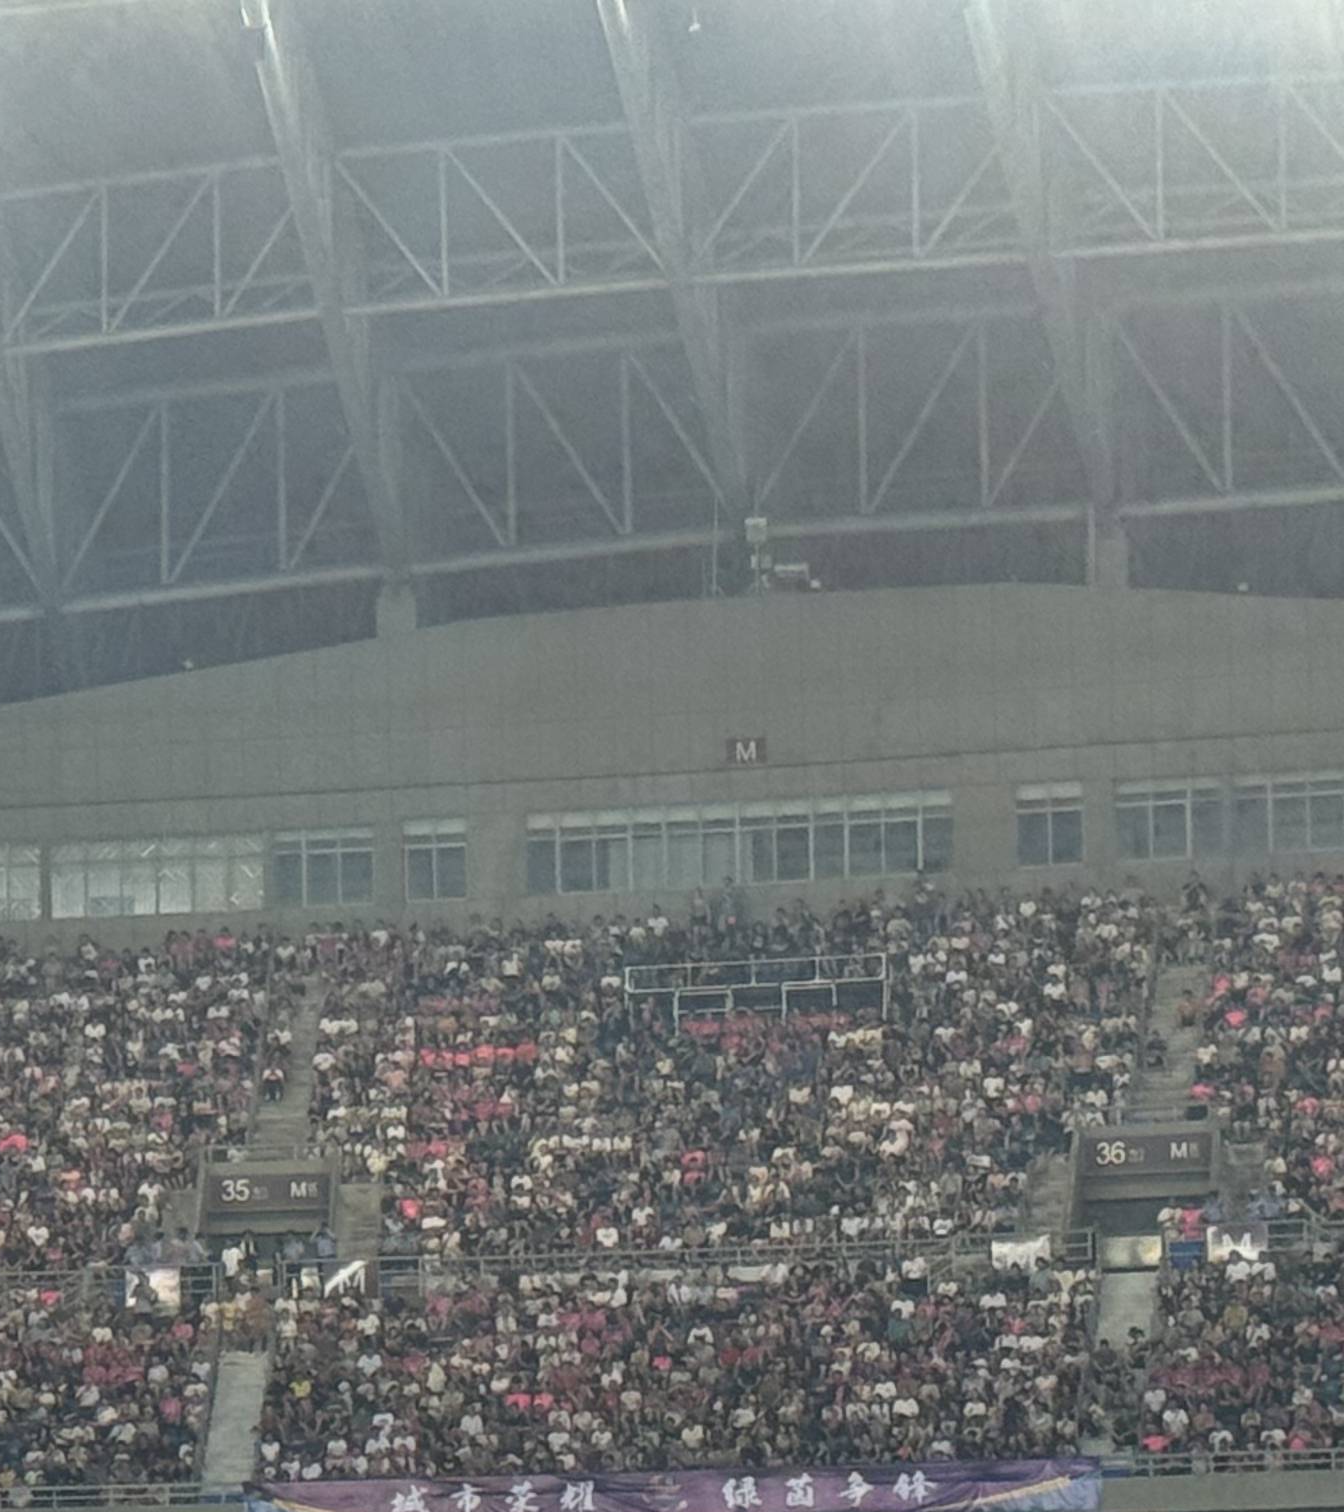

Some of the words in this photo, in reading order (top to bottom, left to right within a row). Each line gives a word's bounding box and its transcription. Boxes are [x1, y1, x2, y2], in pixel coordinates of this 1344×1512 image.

[735, 741, 757, 762] M
[1096, 1142, 1125, 1166] 36
[221, 1179, 250, 1202] 35
[722, 1470, 938, 1509] 绿茵争锋
